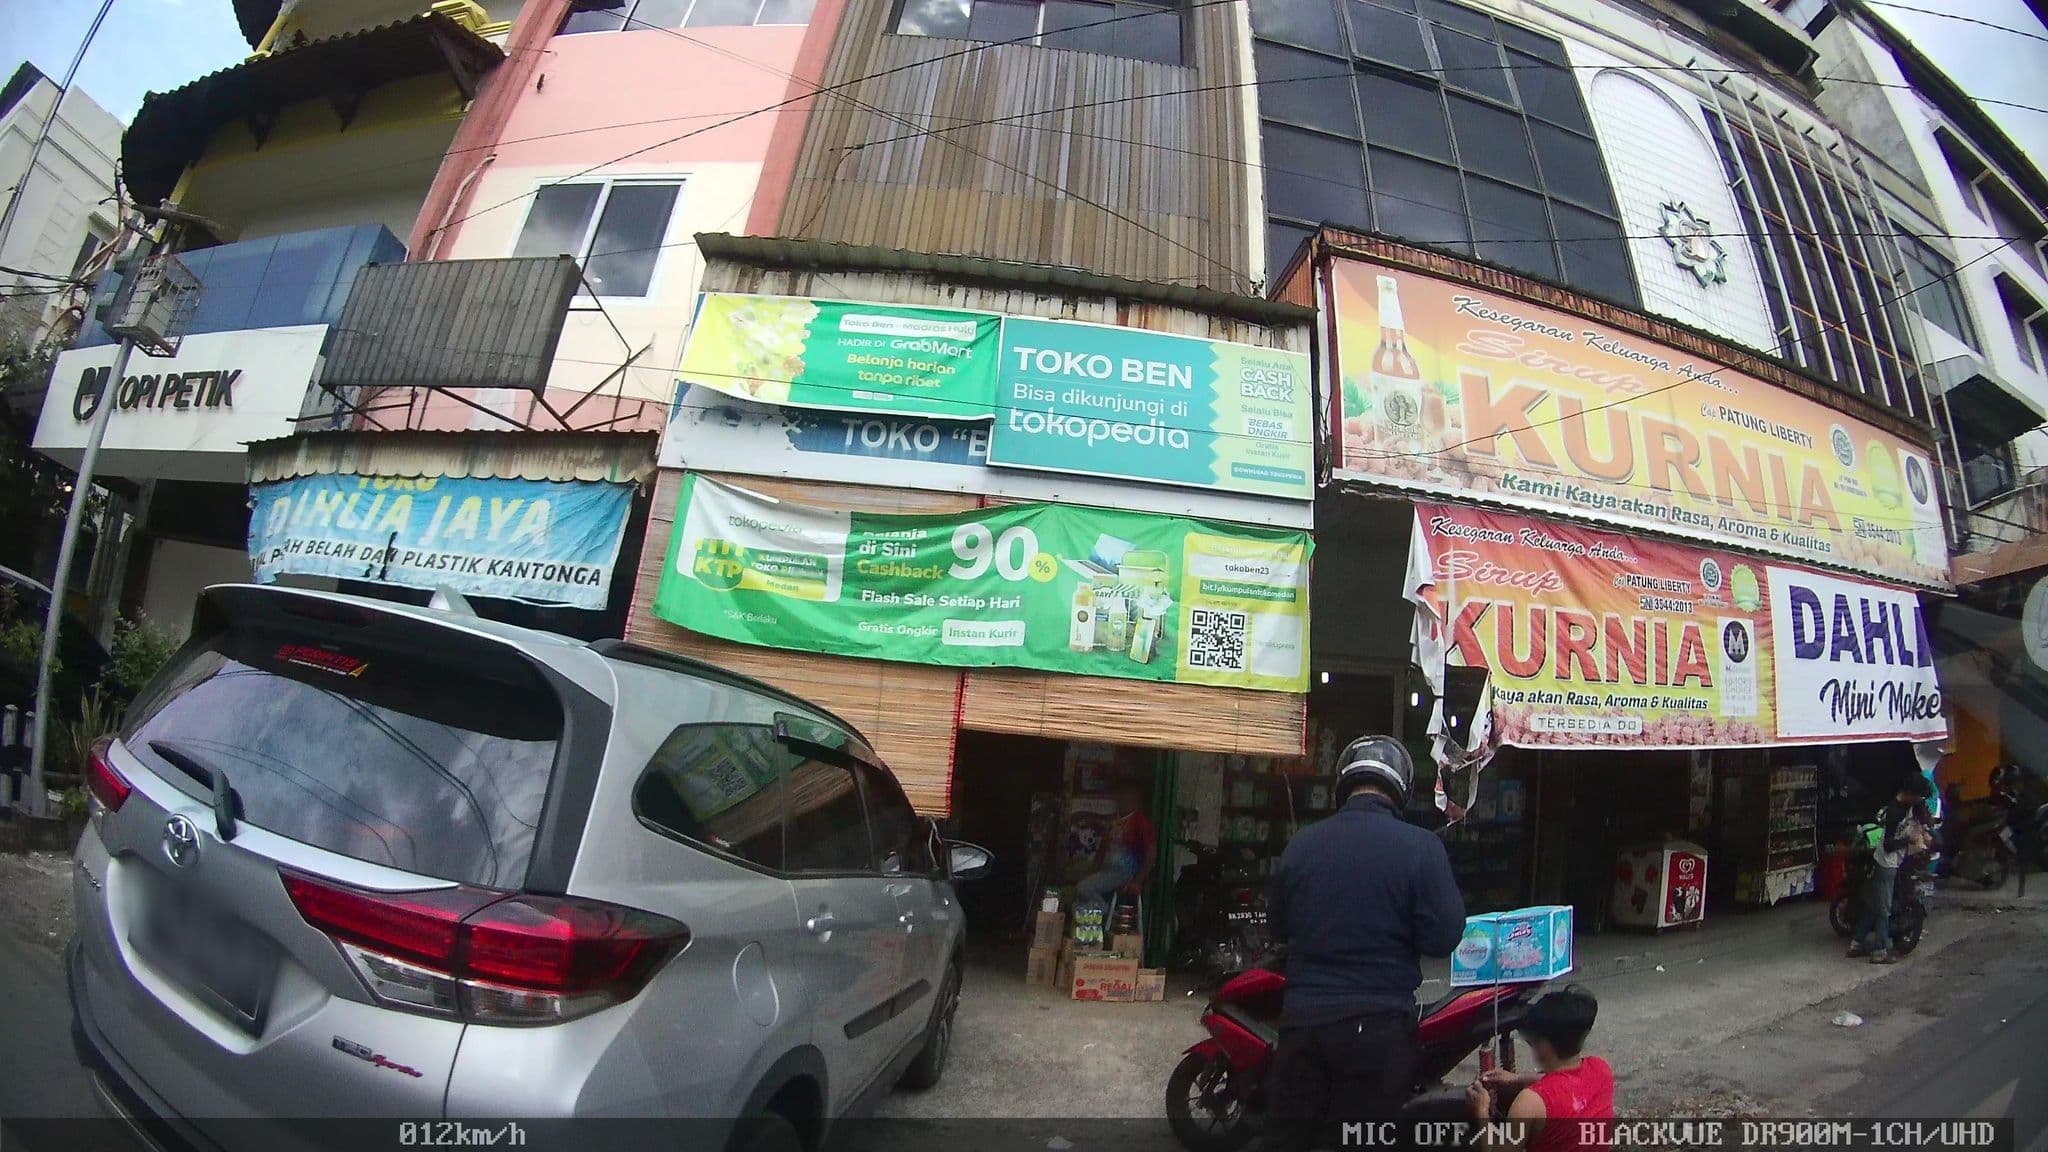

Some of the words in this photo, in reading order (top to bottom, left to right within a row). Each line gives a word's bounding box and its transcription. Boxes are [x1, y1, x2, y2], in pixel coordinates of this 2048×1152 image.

[1453, 297, 1574, 341] Kesegaran
[1582, 332, 1670, 371] Keluarga
[838, 337, 872, 347] HADIR
[889, 339, 973, 359] GrabMart
[848, 353, 904, 369] Belanja
[907, 357, 956, 375] harian
[1013, 346, 1113, 380] TOKO
[1121, 358, 1193, 390] BEN
[1457, 329, 1646, 394] Sirup
[858, 370, 903, 385] tanpa
[905, 374, 942, 388] ribet
[1241, 367, 1292, 387] CASH
[158, 369, 243, 408] PETIK
[1241, 382, 1294, 403] BACK
[1014, 383, 1055, 402] Bisa
[1062, 385, 1165, 417] dikunjungi
[1171, 400, 1188, 417] di
[1241, 404, 1271, 416] Selalu
[842, 418, 940, 452] TOKO
[1009, 407, 1189, 449] tokopedia
[1248, 418, 1283, 430] BEBAS
[1719, 406, 1767, 433] PATUNG
[1770, 423, 1813, 449] LIBERTY
[1457, 365, 1843, 533] KURNIA
[418, 495, 551, 545] JAYA
[1502, 473, 1559, 498] Kami
[1565, 483, 1617, 509] Kaya
[1621, 497, 1666, 519] akan
[1671, 506, 1714, 531] Rasa,
[1718, 516, 1767, 539] Aroma
[1771, 527, 1780, 541] &
[1782, 530, 1832, 553] Kualitas
[1431, 516, 1514, 545] Kesegaran
[1519, 527, 1584, 558] Keluarga
[859, 540, 877, 555] di
[881, 542, 917, 558] Sini
[305, 540, 357, 558] BELAH
[402, 551, 483, 574] PLASTIK
[487, 559, 601, 586] KANTONGA
[694, 556, 743, 578] KTP
[857, 559, 943, 579] Cashback
[1225, 563, 1270, 575] tokoben23
[1433, 549, 1564, 597] Sirup
[767, 579, 799, 591] Medan
[1626, 574, 1659, 590] PATUNG
[1659, 578, 1691, 593] LIBERTY
[861, 589, 899, 604] Flash
[904, 594, 935, 607] Sale
[939, 595, 986, 610] Setiap
[989, 595, 1020, 609] Hari
[1654, 597, 1693, 613] 3544:2013
[746, 613, 777, 624] Berlaku
[858, 621, 894, 634] Gratis
[899, 624, 938, 637] Ongkir
[949, 627, 985, 639] Instan
[988, 627, 1017, 639] Kurir
[1432, 597, 1714, 688] KURNIA
[1491, 686, 1524, 704] Kaya
[1527, 689, 1563, 705] akan
[1566, 691, 1601, 708] Rasa,
[1604, 693, 1648, 708] Aroma
[1650, 695, 1658, 708] &
[1662, 696, 1709, 710] Kualitas
[1819, 678, 1876, 726] Mini
[1537, 717, 1611, 730] TERSEDIA
